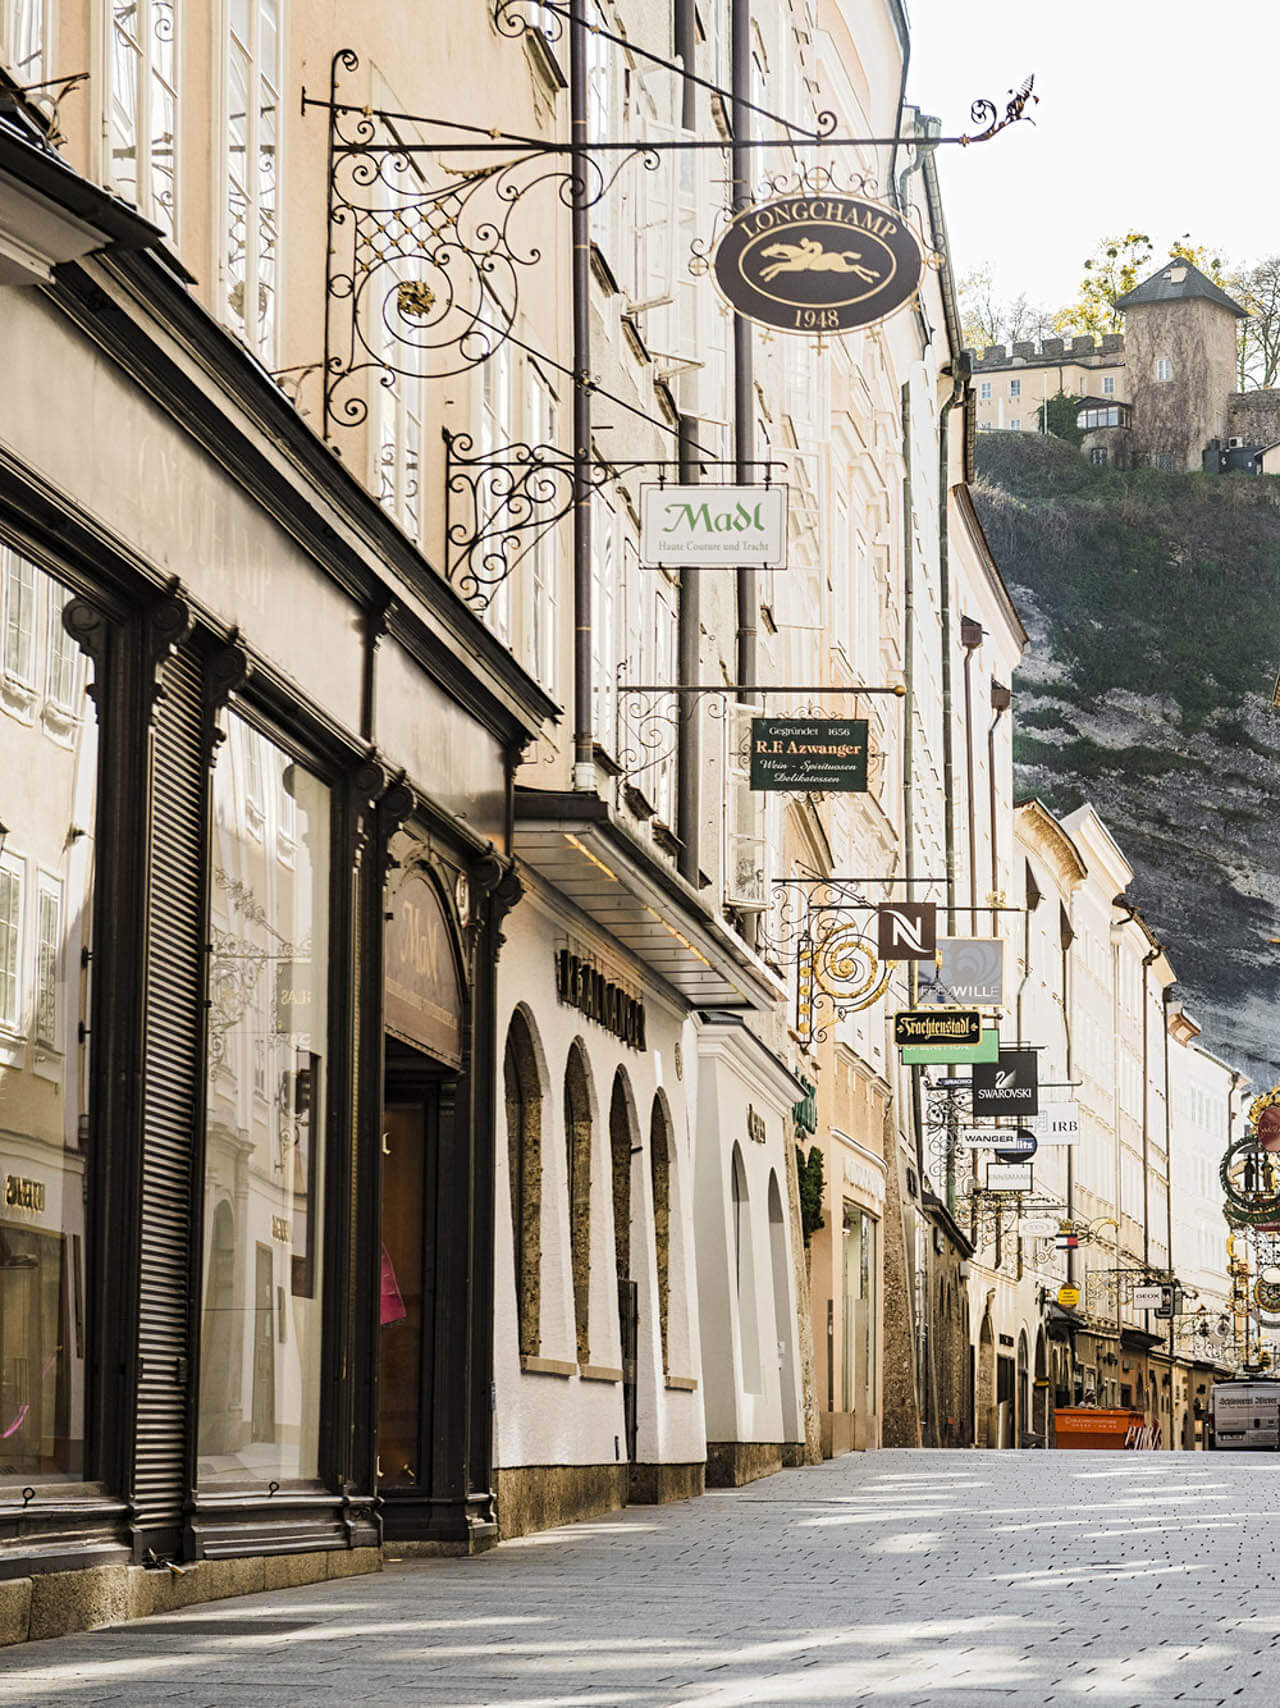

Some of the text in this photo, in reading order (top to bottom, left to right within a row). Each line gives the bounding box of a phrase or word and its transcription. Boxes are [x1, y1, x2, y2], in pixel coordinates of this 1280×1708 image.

[740, 201, 898, 239] LONGCHAMP
[794, 310, 840, 328] 1948
[662, 501, 767, 533] Madl
[658, 541, 684, 551] Haute
[723, 541, 743, 551] und
[769, 727, 850, 736] Gegründet 1656
[786, 741, 862, 757] Azwanger
[886, 911, 928, 950] N
[900, 1017, 970, 1040] Trachtenstadl
[978, 1088, 1032, 1099] SWAROVSKI
[1052, 1121, 1078, 1132] IRB
